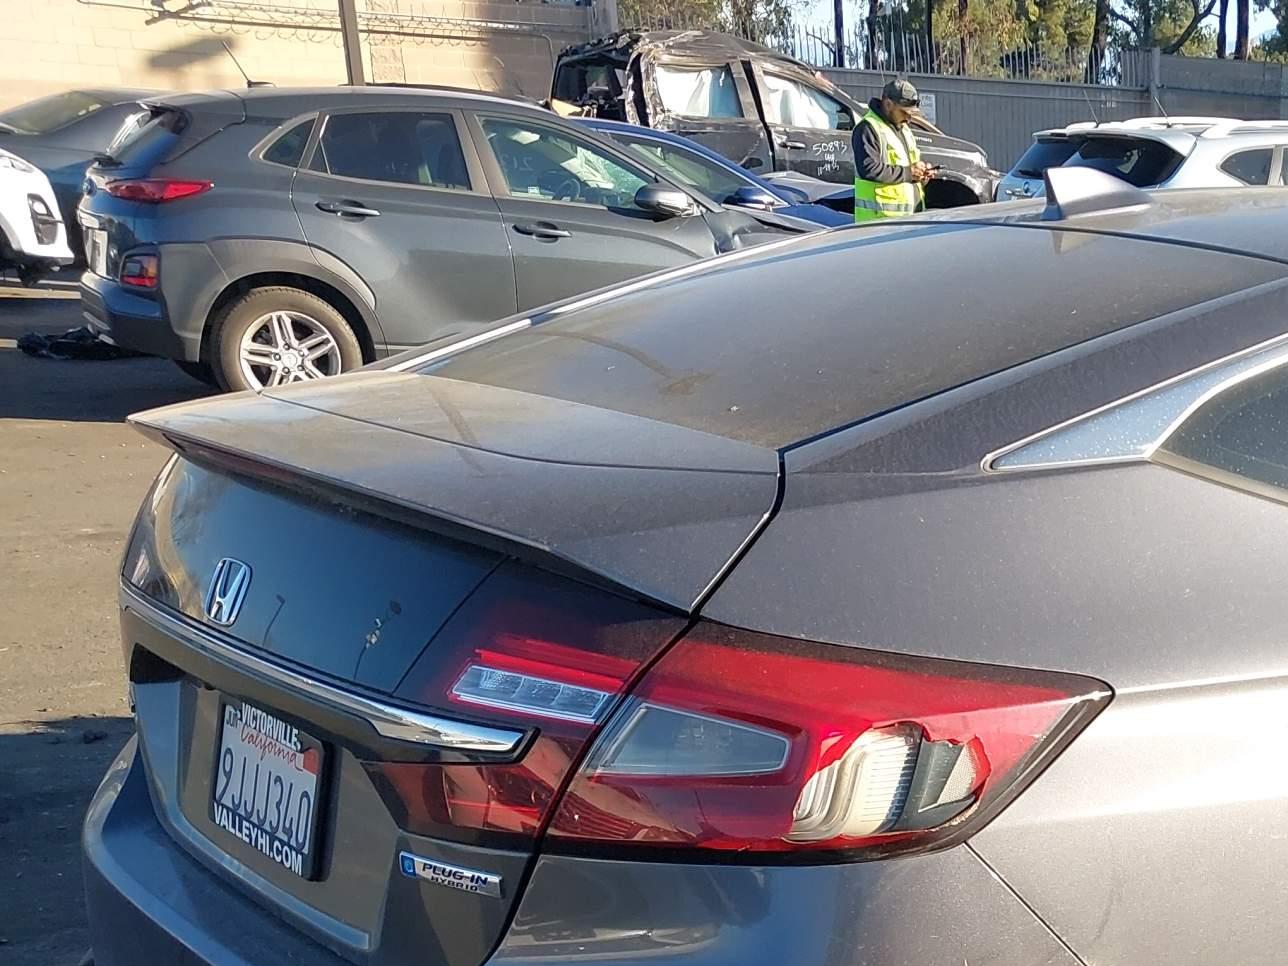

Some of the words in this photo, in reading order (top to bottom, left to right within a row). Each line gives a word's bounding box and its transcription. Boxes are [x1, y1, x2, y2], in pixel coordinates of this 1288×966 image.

[241, 702, 301, 751] VICTORVILLE
[215, 747, 311, 850] 9JJJ340
[213, 802, 303, 876] VALLEYHI.COM
[422, 862, 488, 885] PLUG-IN
[430, 875, 479, 892] HYBRID
